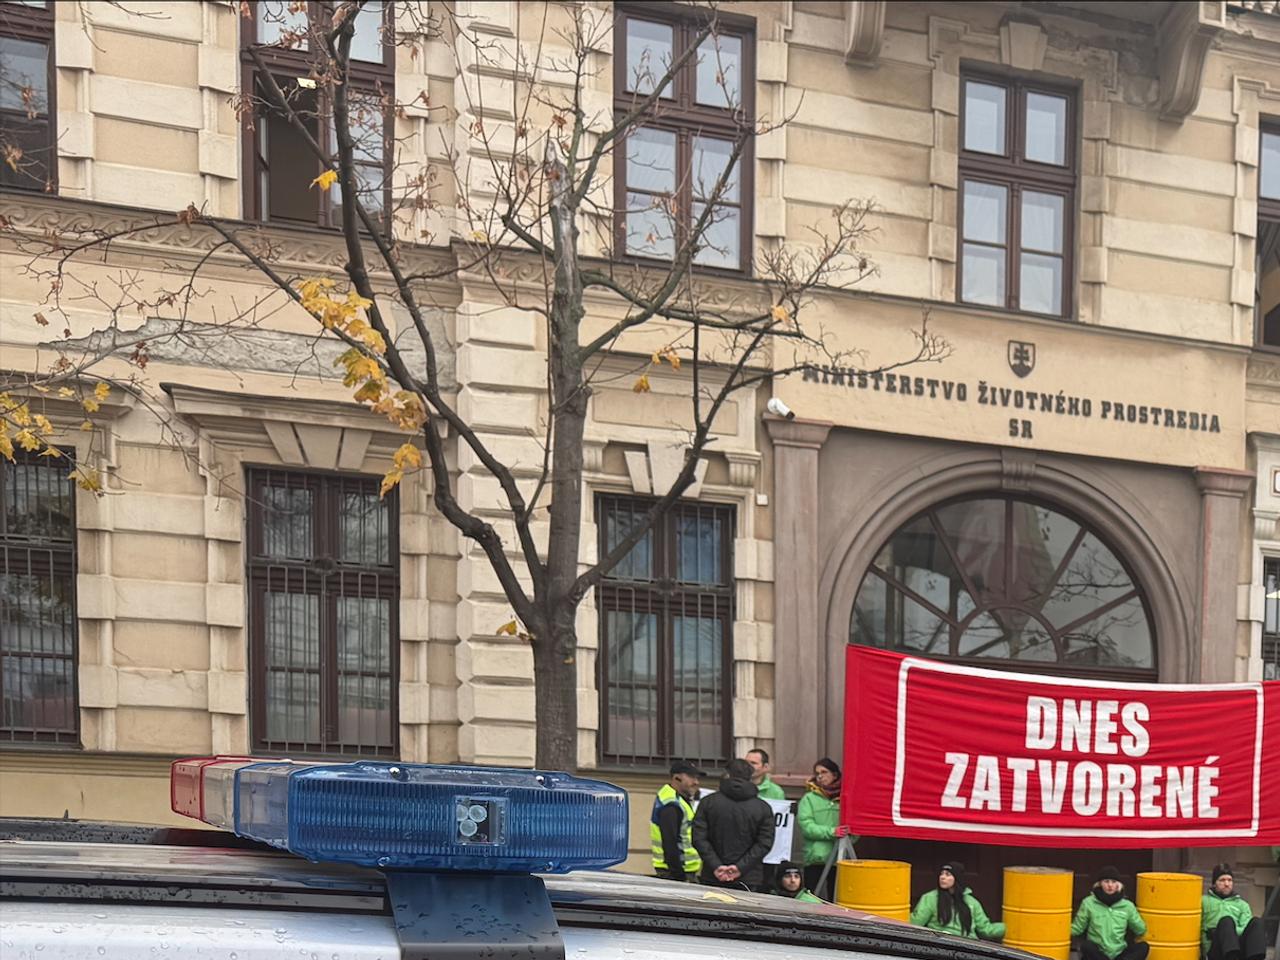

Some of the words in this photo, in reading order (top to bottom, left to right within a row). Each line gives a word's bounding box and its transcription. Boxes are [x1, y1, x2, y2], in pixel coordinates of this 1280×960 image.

[802, 365, 968, 402] MINISTERSTVO
[977, 381, 1093, 417] ŽIVOTNÉHO
[1100, 400, 1221, 433] PROSTREDIA
[1008, 418, 1034, 439] SR
[1025, 695, 1150, 757] DNES
[940, 752, 1221, 819] ZATVORENÉ
